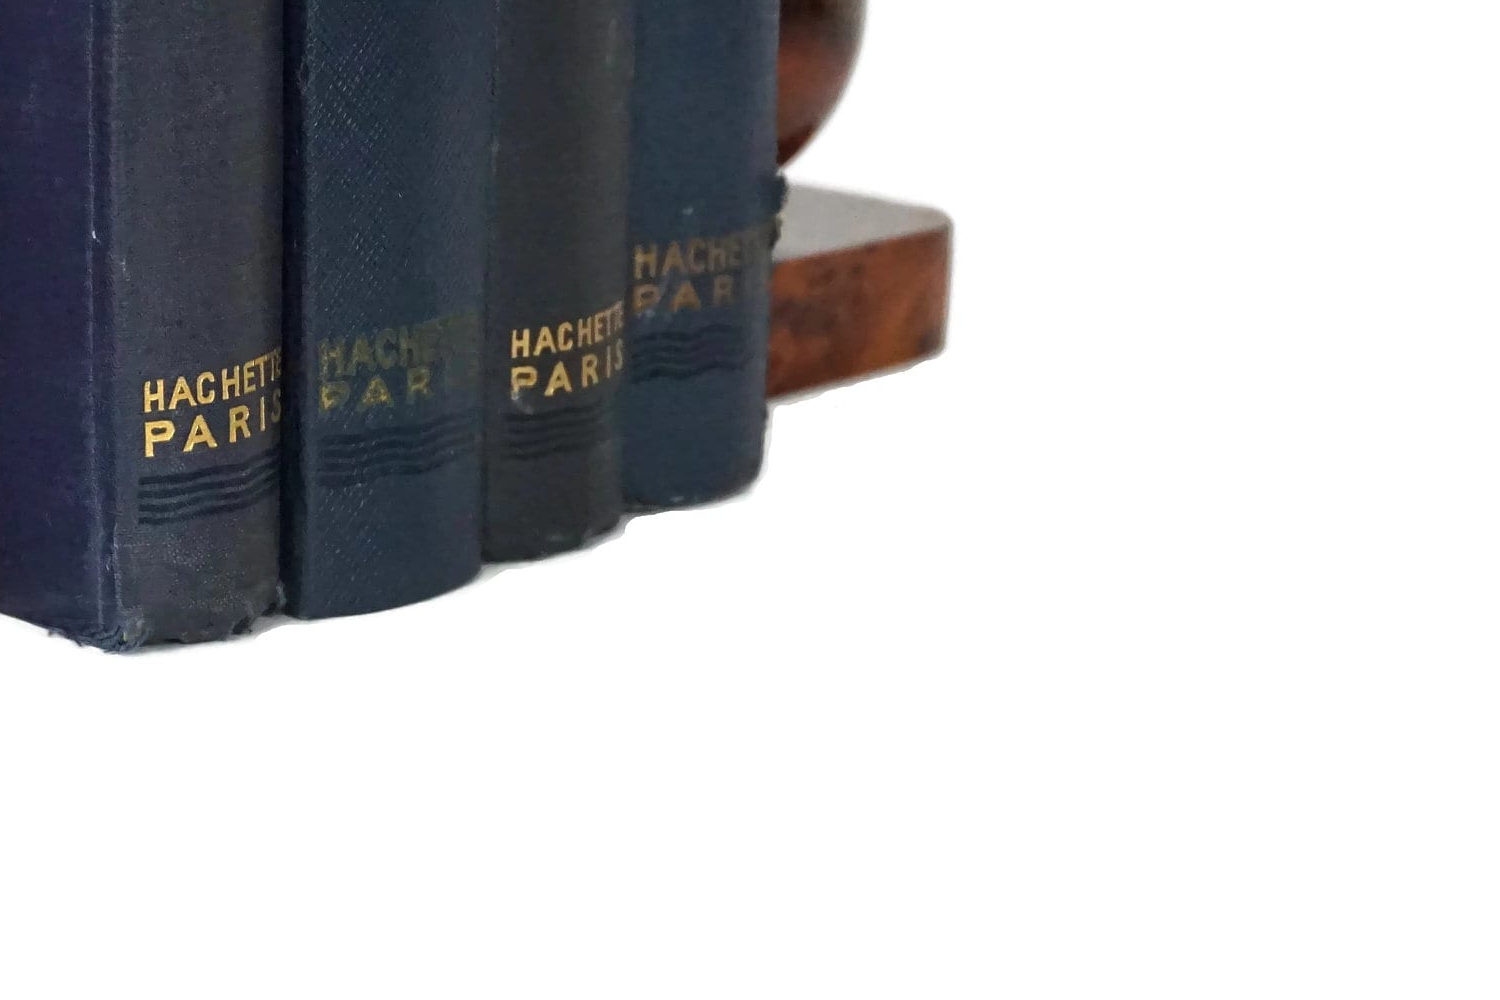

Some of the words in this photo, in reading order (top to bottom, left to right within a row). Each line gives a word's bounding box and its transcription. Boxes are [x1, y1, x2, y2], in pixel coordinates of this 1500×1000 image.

[633, 226, 768, 280] HACHE
[510, 338, 624, 399] PARIS
[143, 388, 282, 458] PARIS
